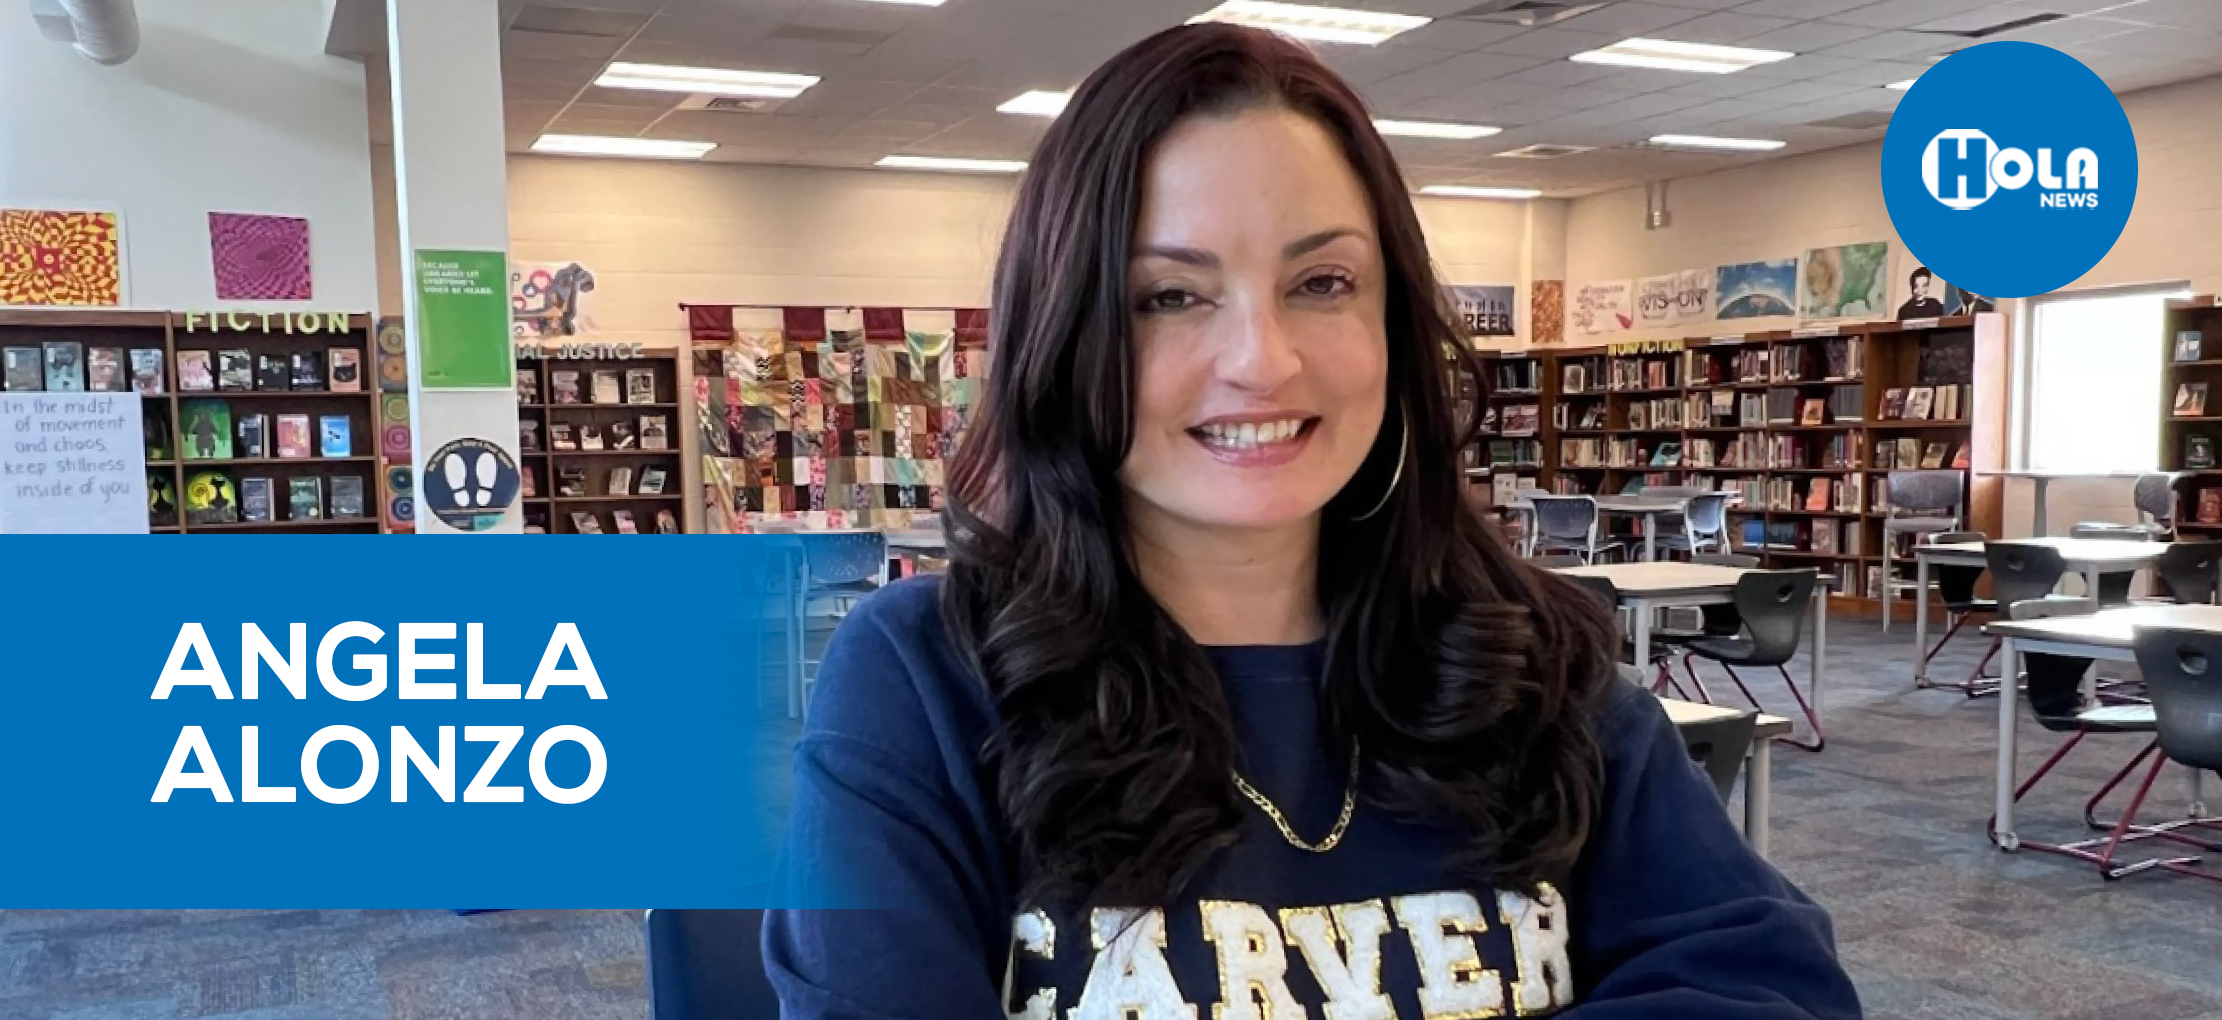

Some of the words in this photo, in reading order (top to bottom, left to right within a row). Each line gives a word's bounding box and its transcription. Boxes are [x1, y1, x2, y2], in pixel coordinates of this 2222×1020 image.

[184, 310, 349, 335] FICTION
[557, 342, 645, 360] JUSTICE
[4, 400, 24, 414] In
[33, 399, 57, 414] the
[64, 397, 114, 414] midst
[14, 416, 31, 432] of
[40, 415, 125, 432] movement
[15, 436, 47, 452] and
[4, 461, 46, 475] keep
[57, 458, 124, 473] stillness
[17, 480, 73, 498] inside
[79, 476, 96, 495] of
[100, 482, 130, 503] you
[1002, 881, 1574, 1020] CARVER
